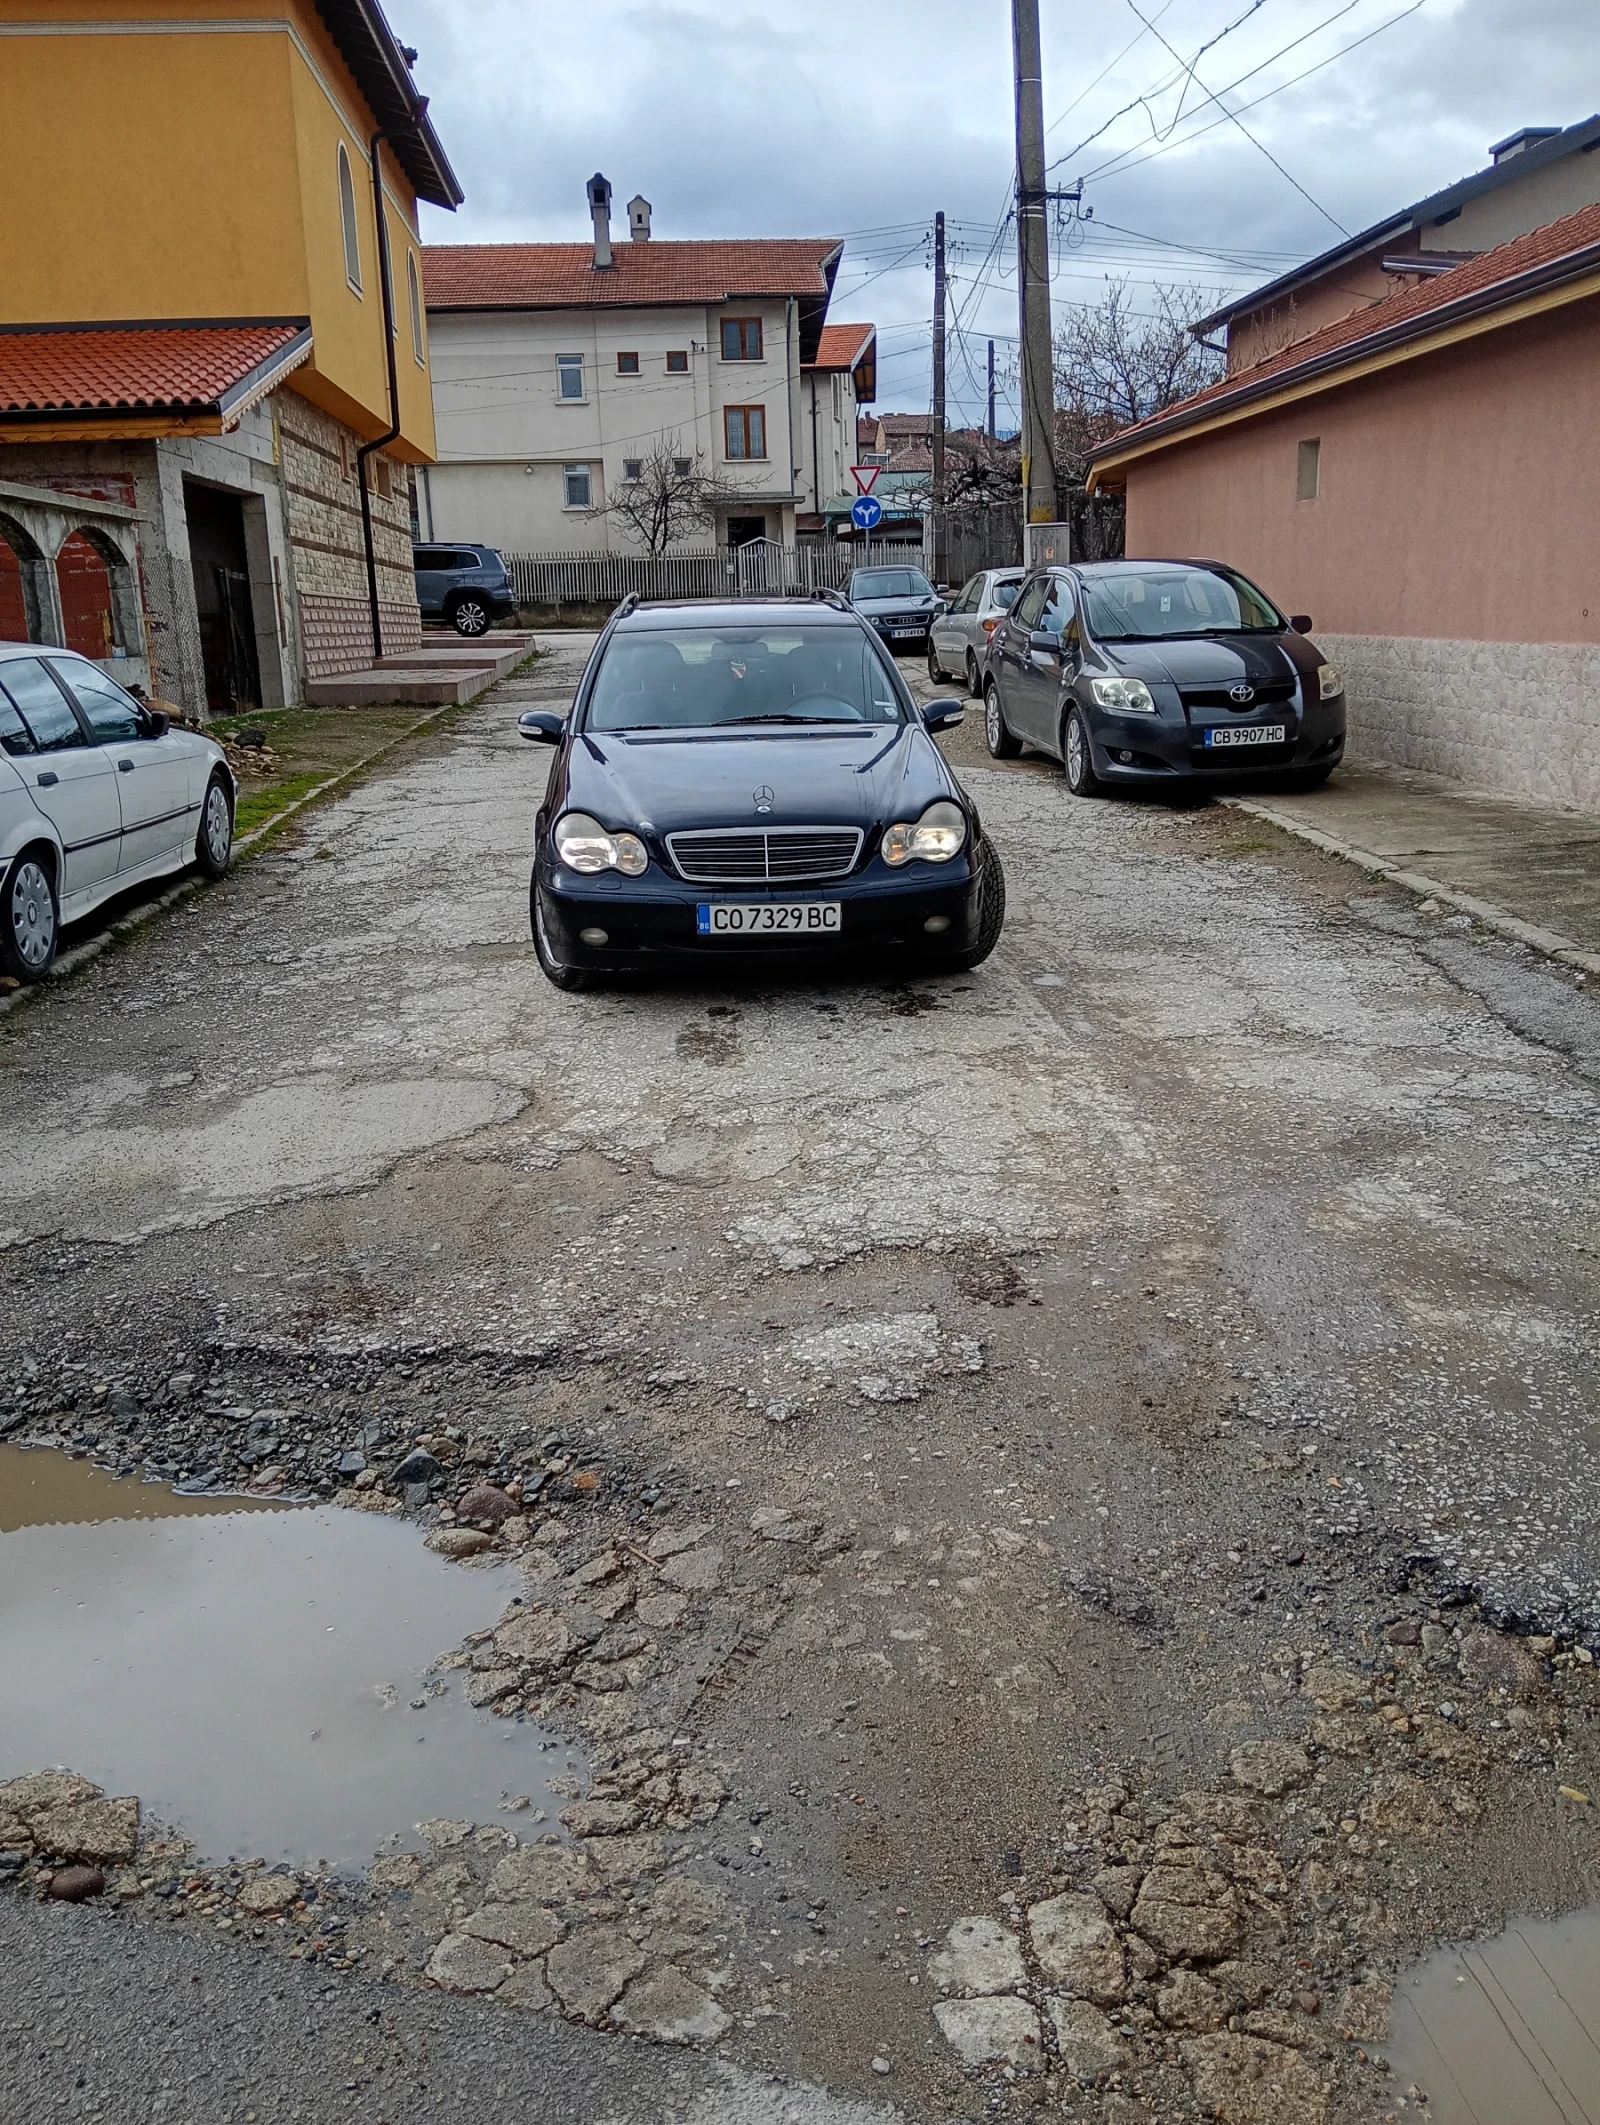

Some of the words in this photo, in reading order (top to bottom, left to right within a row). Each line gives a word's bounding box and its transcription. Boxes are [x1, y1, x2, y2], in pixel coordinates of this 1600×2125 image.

[1214, 730, 1230, 744] CB
[1233, 728, 1264, 743] 9907
[1266, 727, 1283, 741] HC
[714, 908, 743, 930] CO
[748, 907, 802, 929] 7329
[808, 906, 837, 929] BC
